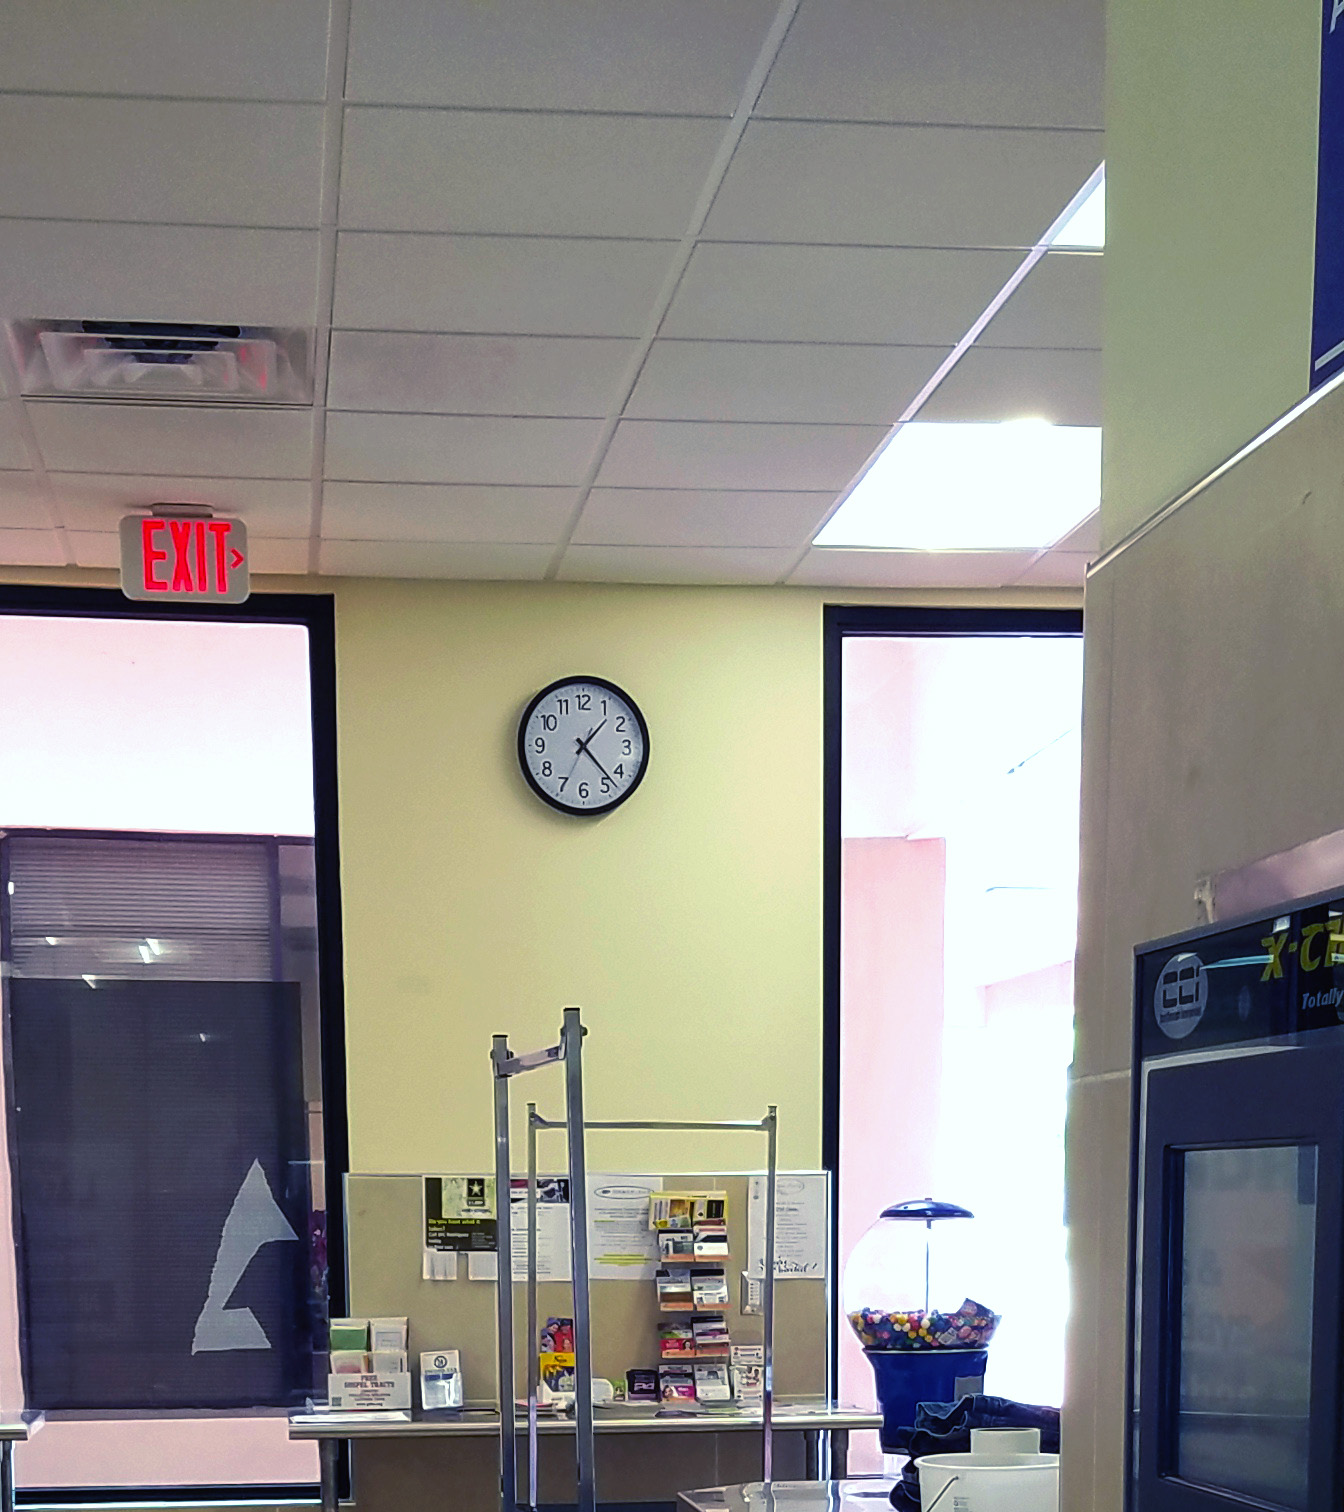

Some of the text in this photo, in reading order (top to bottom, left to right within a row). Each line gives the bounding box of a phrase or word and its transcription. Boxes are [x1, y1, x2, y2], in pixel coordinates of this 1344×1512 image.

[142, 520, 232, 593] EXIT
[556, 698, 570, 715] 11
[575, 694, 592, 711] 12
[601, 699, 607, 716] 1
[541, 714, 558, 731] 10
[615, 716, 626, 732] 2
[534, 737, 546, 754] 9
[621, 739, 632, 756] 3
[541, 761, 553, 777] 8
[613, 763, 625, 779] 4
[558, 777, 569, 792] 7
[578, 782, 589, 798] 6
[1301, 988, 1344, 1011] Totally
